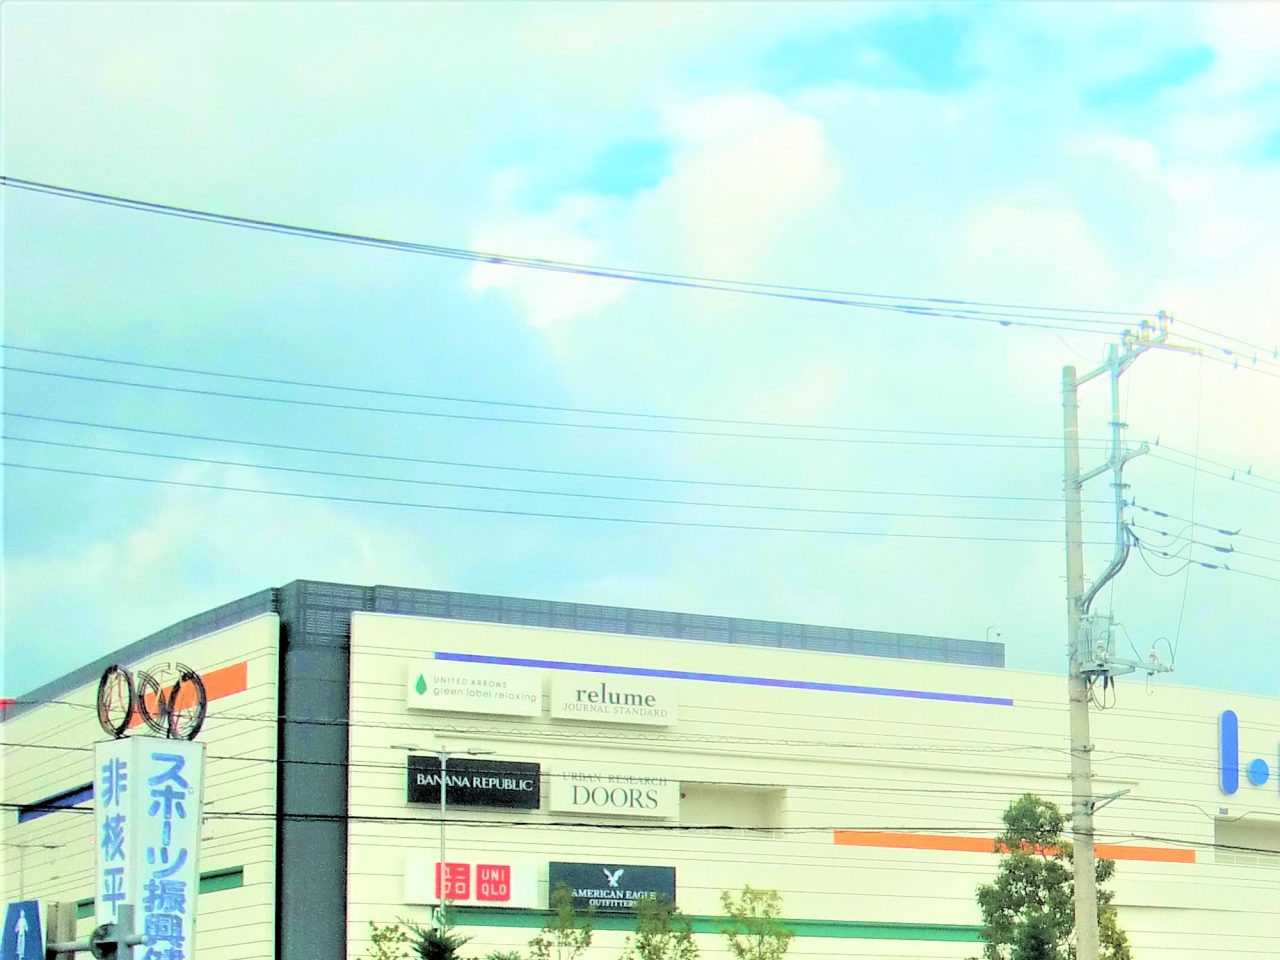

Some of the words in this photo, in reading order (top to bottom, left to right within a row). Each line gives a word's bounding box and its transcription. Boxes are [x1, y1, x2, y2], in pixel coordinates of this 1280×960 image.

[433, 677, 468, 686] UNITED
[471, 680, 507, 688] ARROWS
[433, 687, 464, 696] green
[466, 688, 492, 698] label
[495, 691, 537, 703] relaxing
[576, 683, 656, 707] relume
[563, 703, 610, 713] JOURNAL
[613, 706, 668, 718] STANDARD
[417, 774, 470, 787] BANANA
[473, 777, 533, 791] REPUBLIC
[572, 785, 658, 809] DOORS
[481, 869, 505, 881] UNI
[482, 883, 507, 896] QLO
[571, 888, 623, 899] AMERICAN
